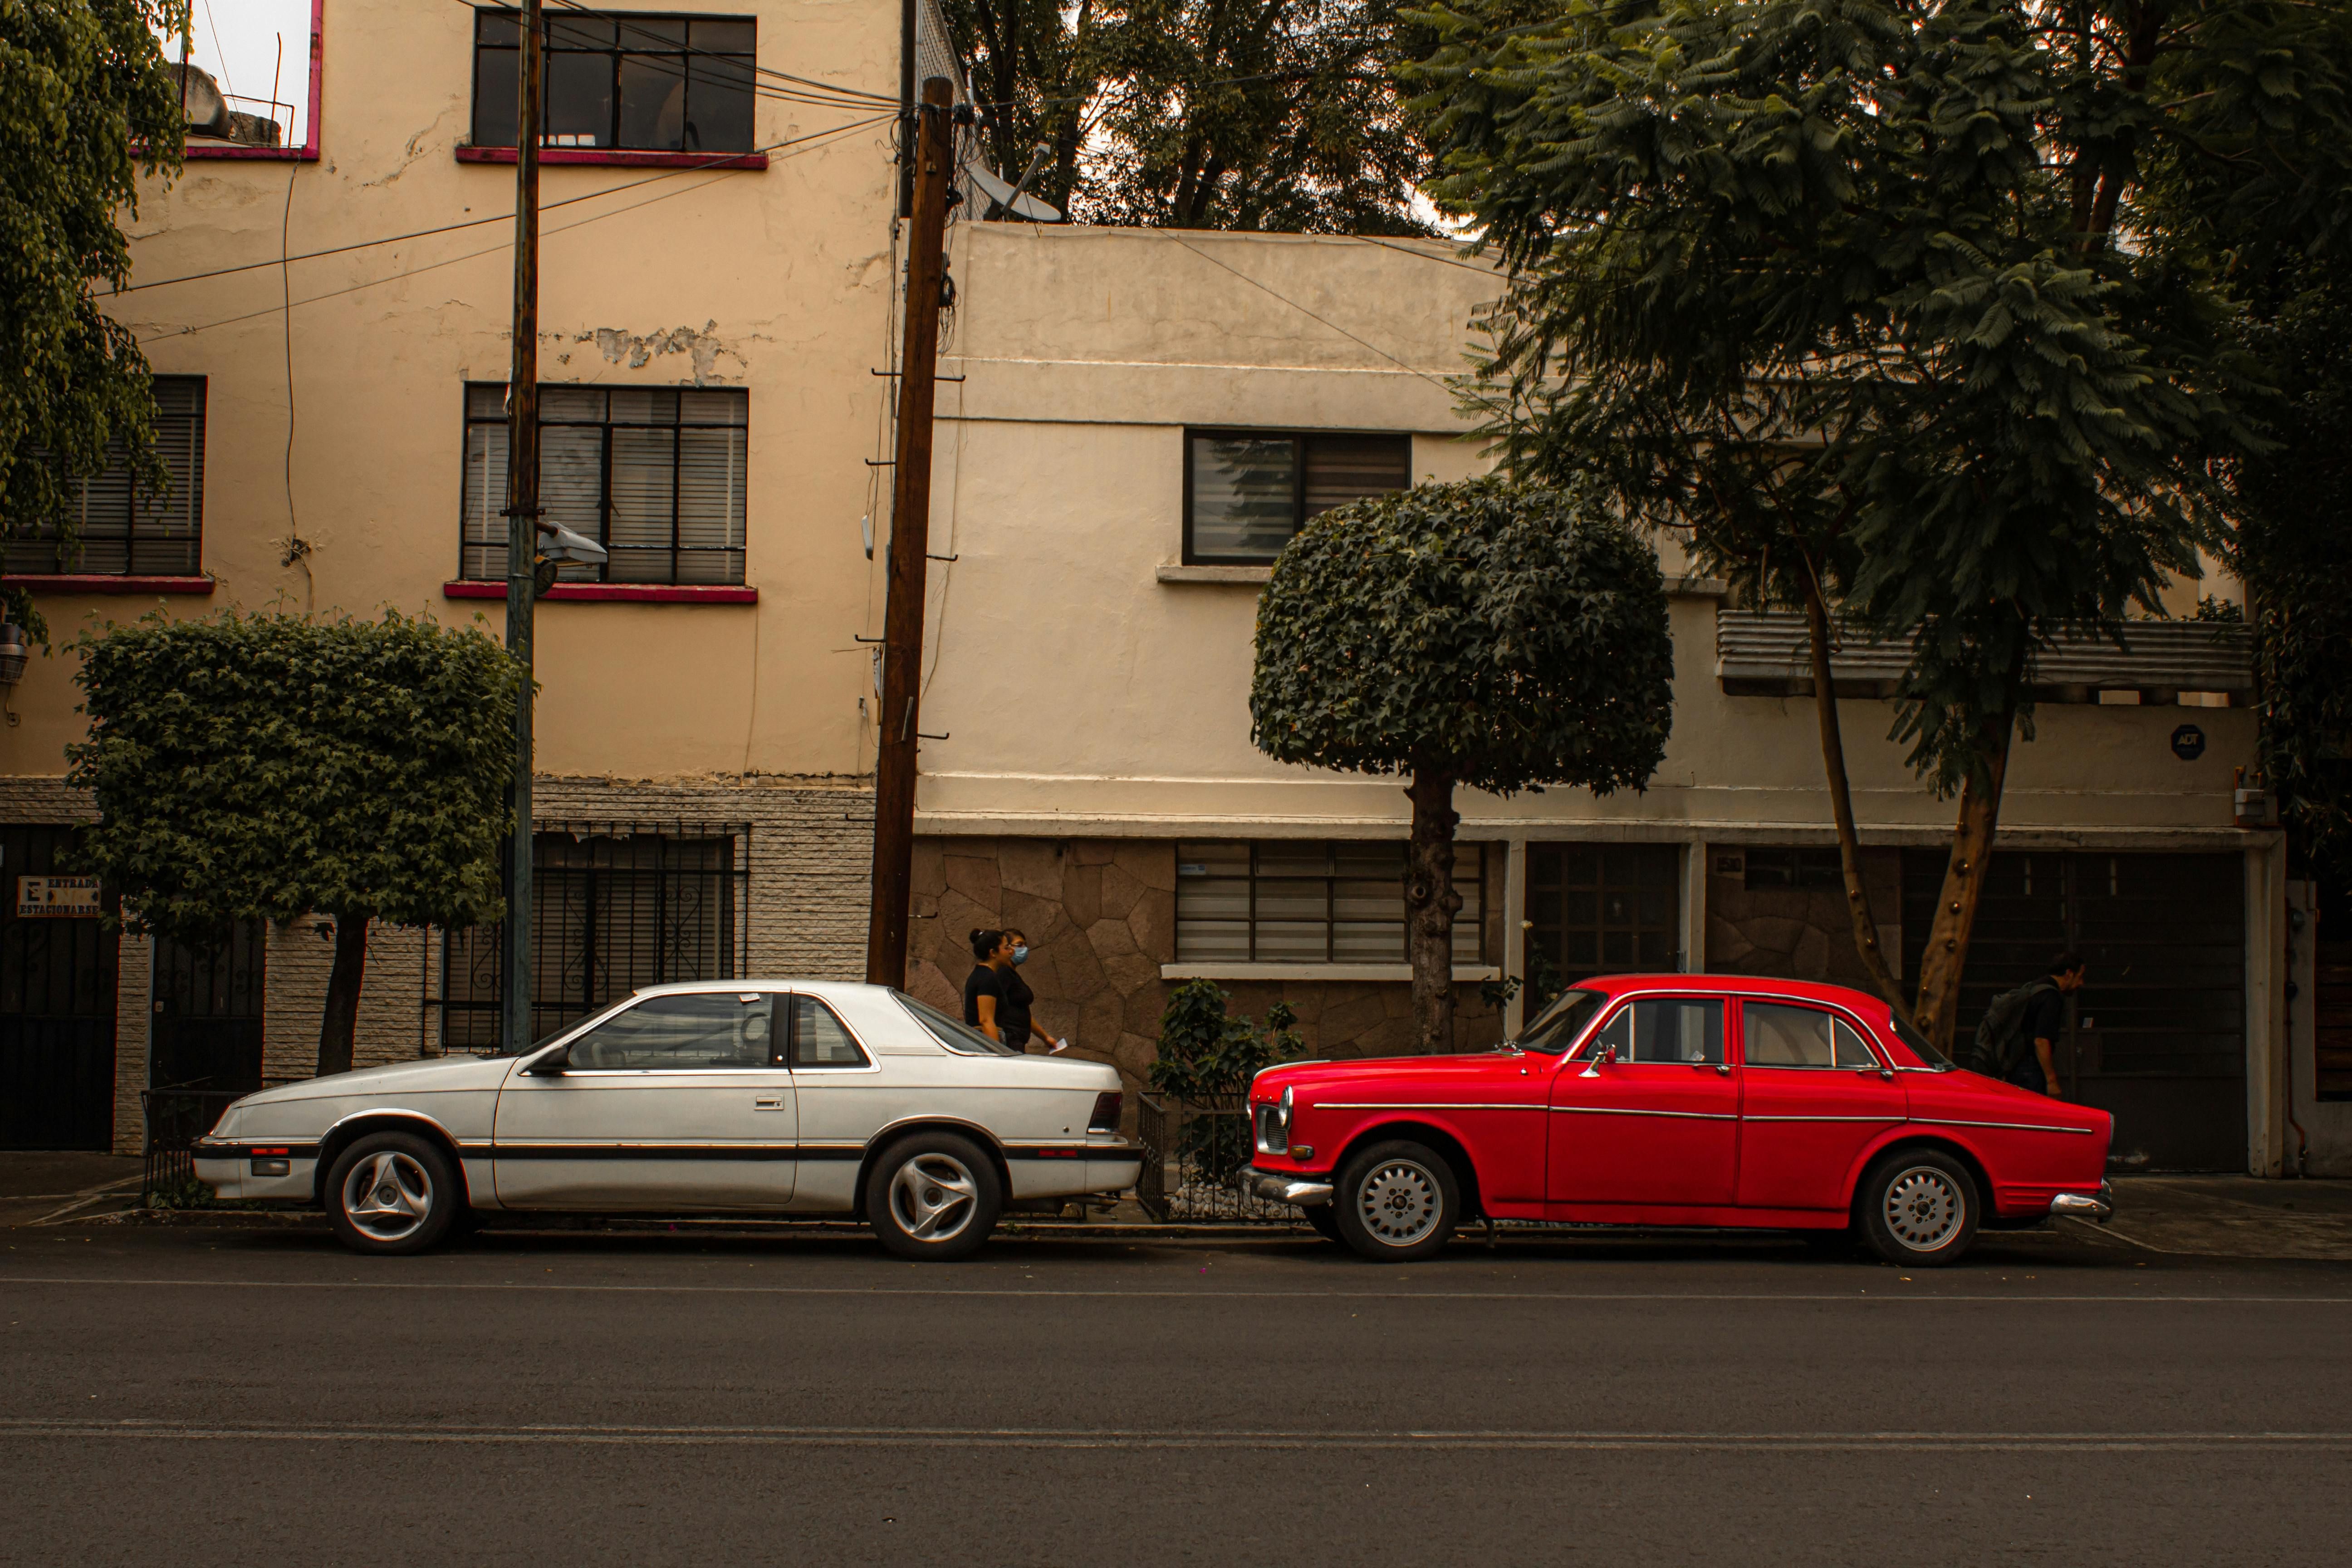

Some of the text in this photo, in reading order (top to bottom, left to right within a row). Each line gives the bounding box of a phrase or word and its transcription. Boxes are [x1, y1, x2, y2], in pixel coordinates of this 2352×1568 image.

[2176, 734, 2199, 745] ADT
[48, 878, 98, 888] ENTRADA
[20, 905, 99, 915] ESTACIONARSE
